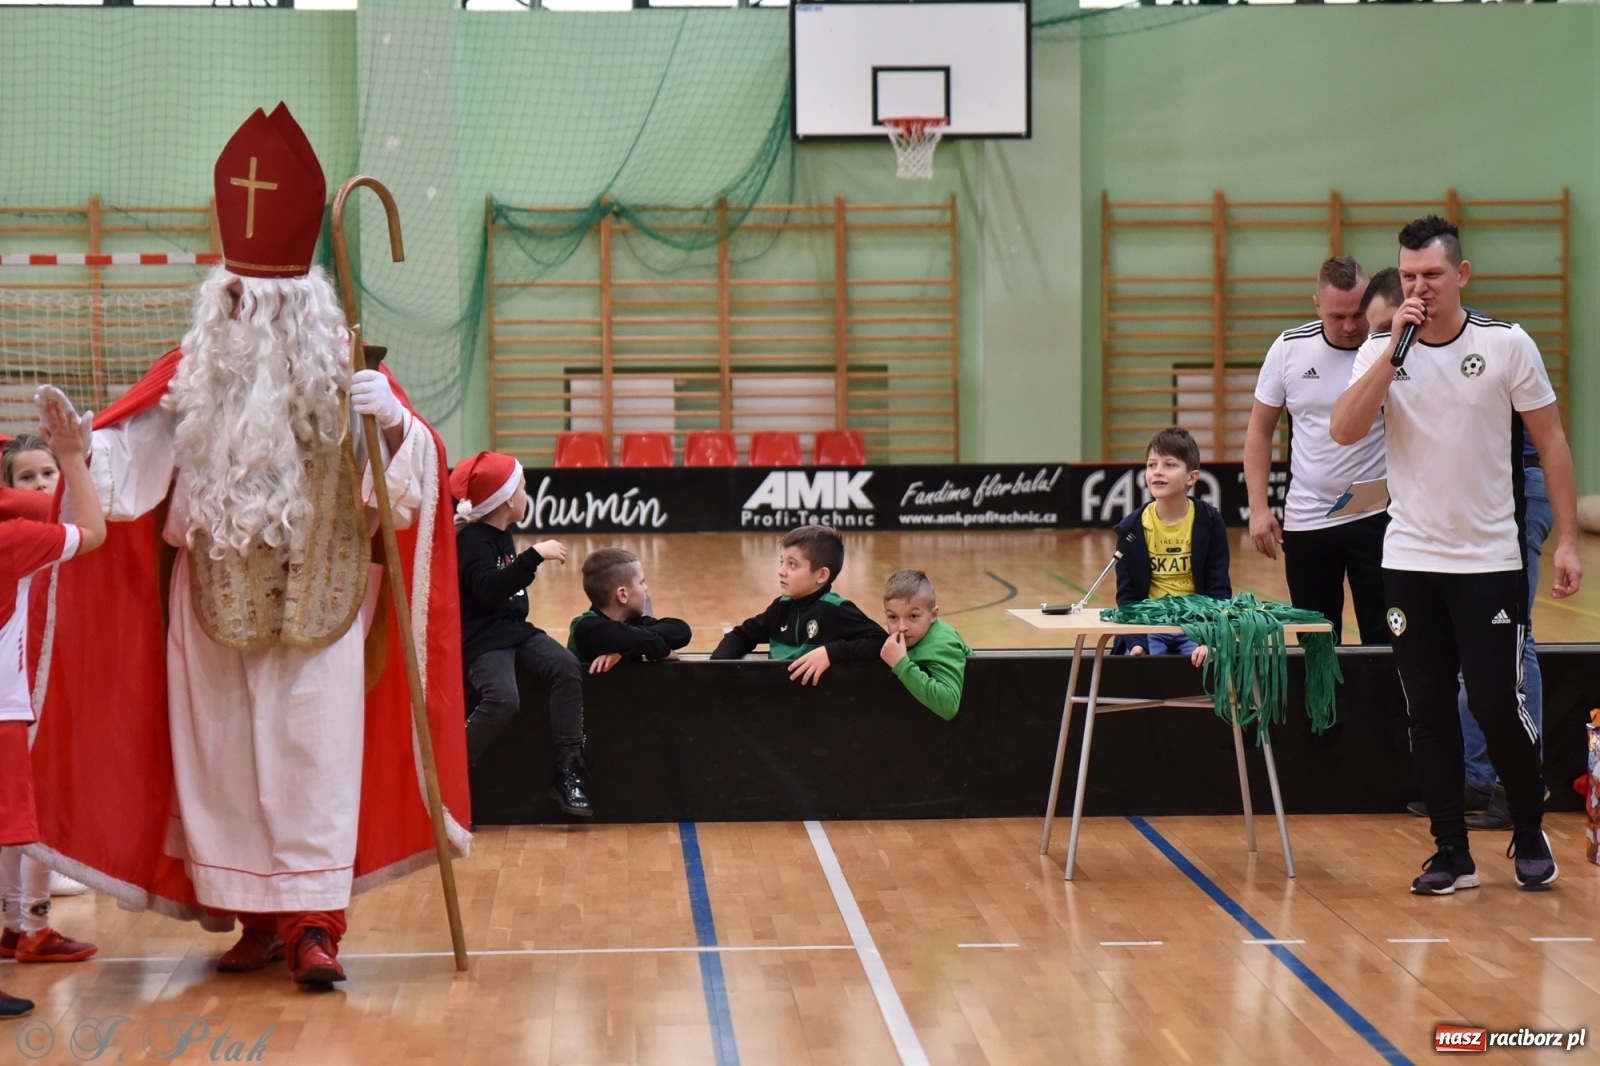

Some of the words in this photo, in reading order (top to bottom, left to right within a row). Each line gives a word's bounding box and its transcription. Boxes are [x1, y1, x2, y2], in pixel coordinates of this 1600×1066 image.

[742, 470, 875, 509] AMK
[516, 475, 669, 529] ohumín
[741, 510, 875, 526] Profi-Technic
[899, 510, 1058, 526] www.amkprofitechnic.cz
[1150, 556, 1191, 572] SKAT
